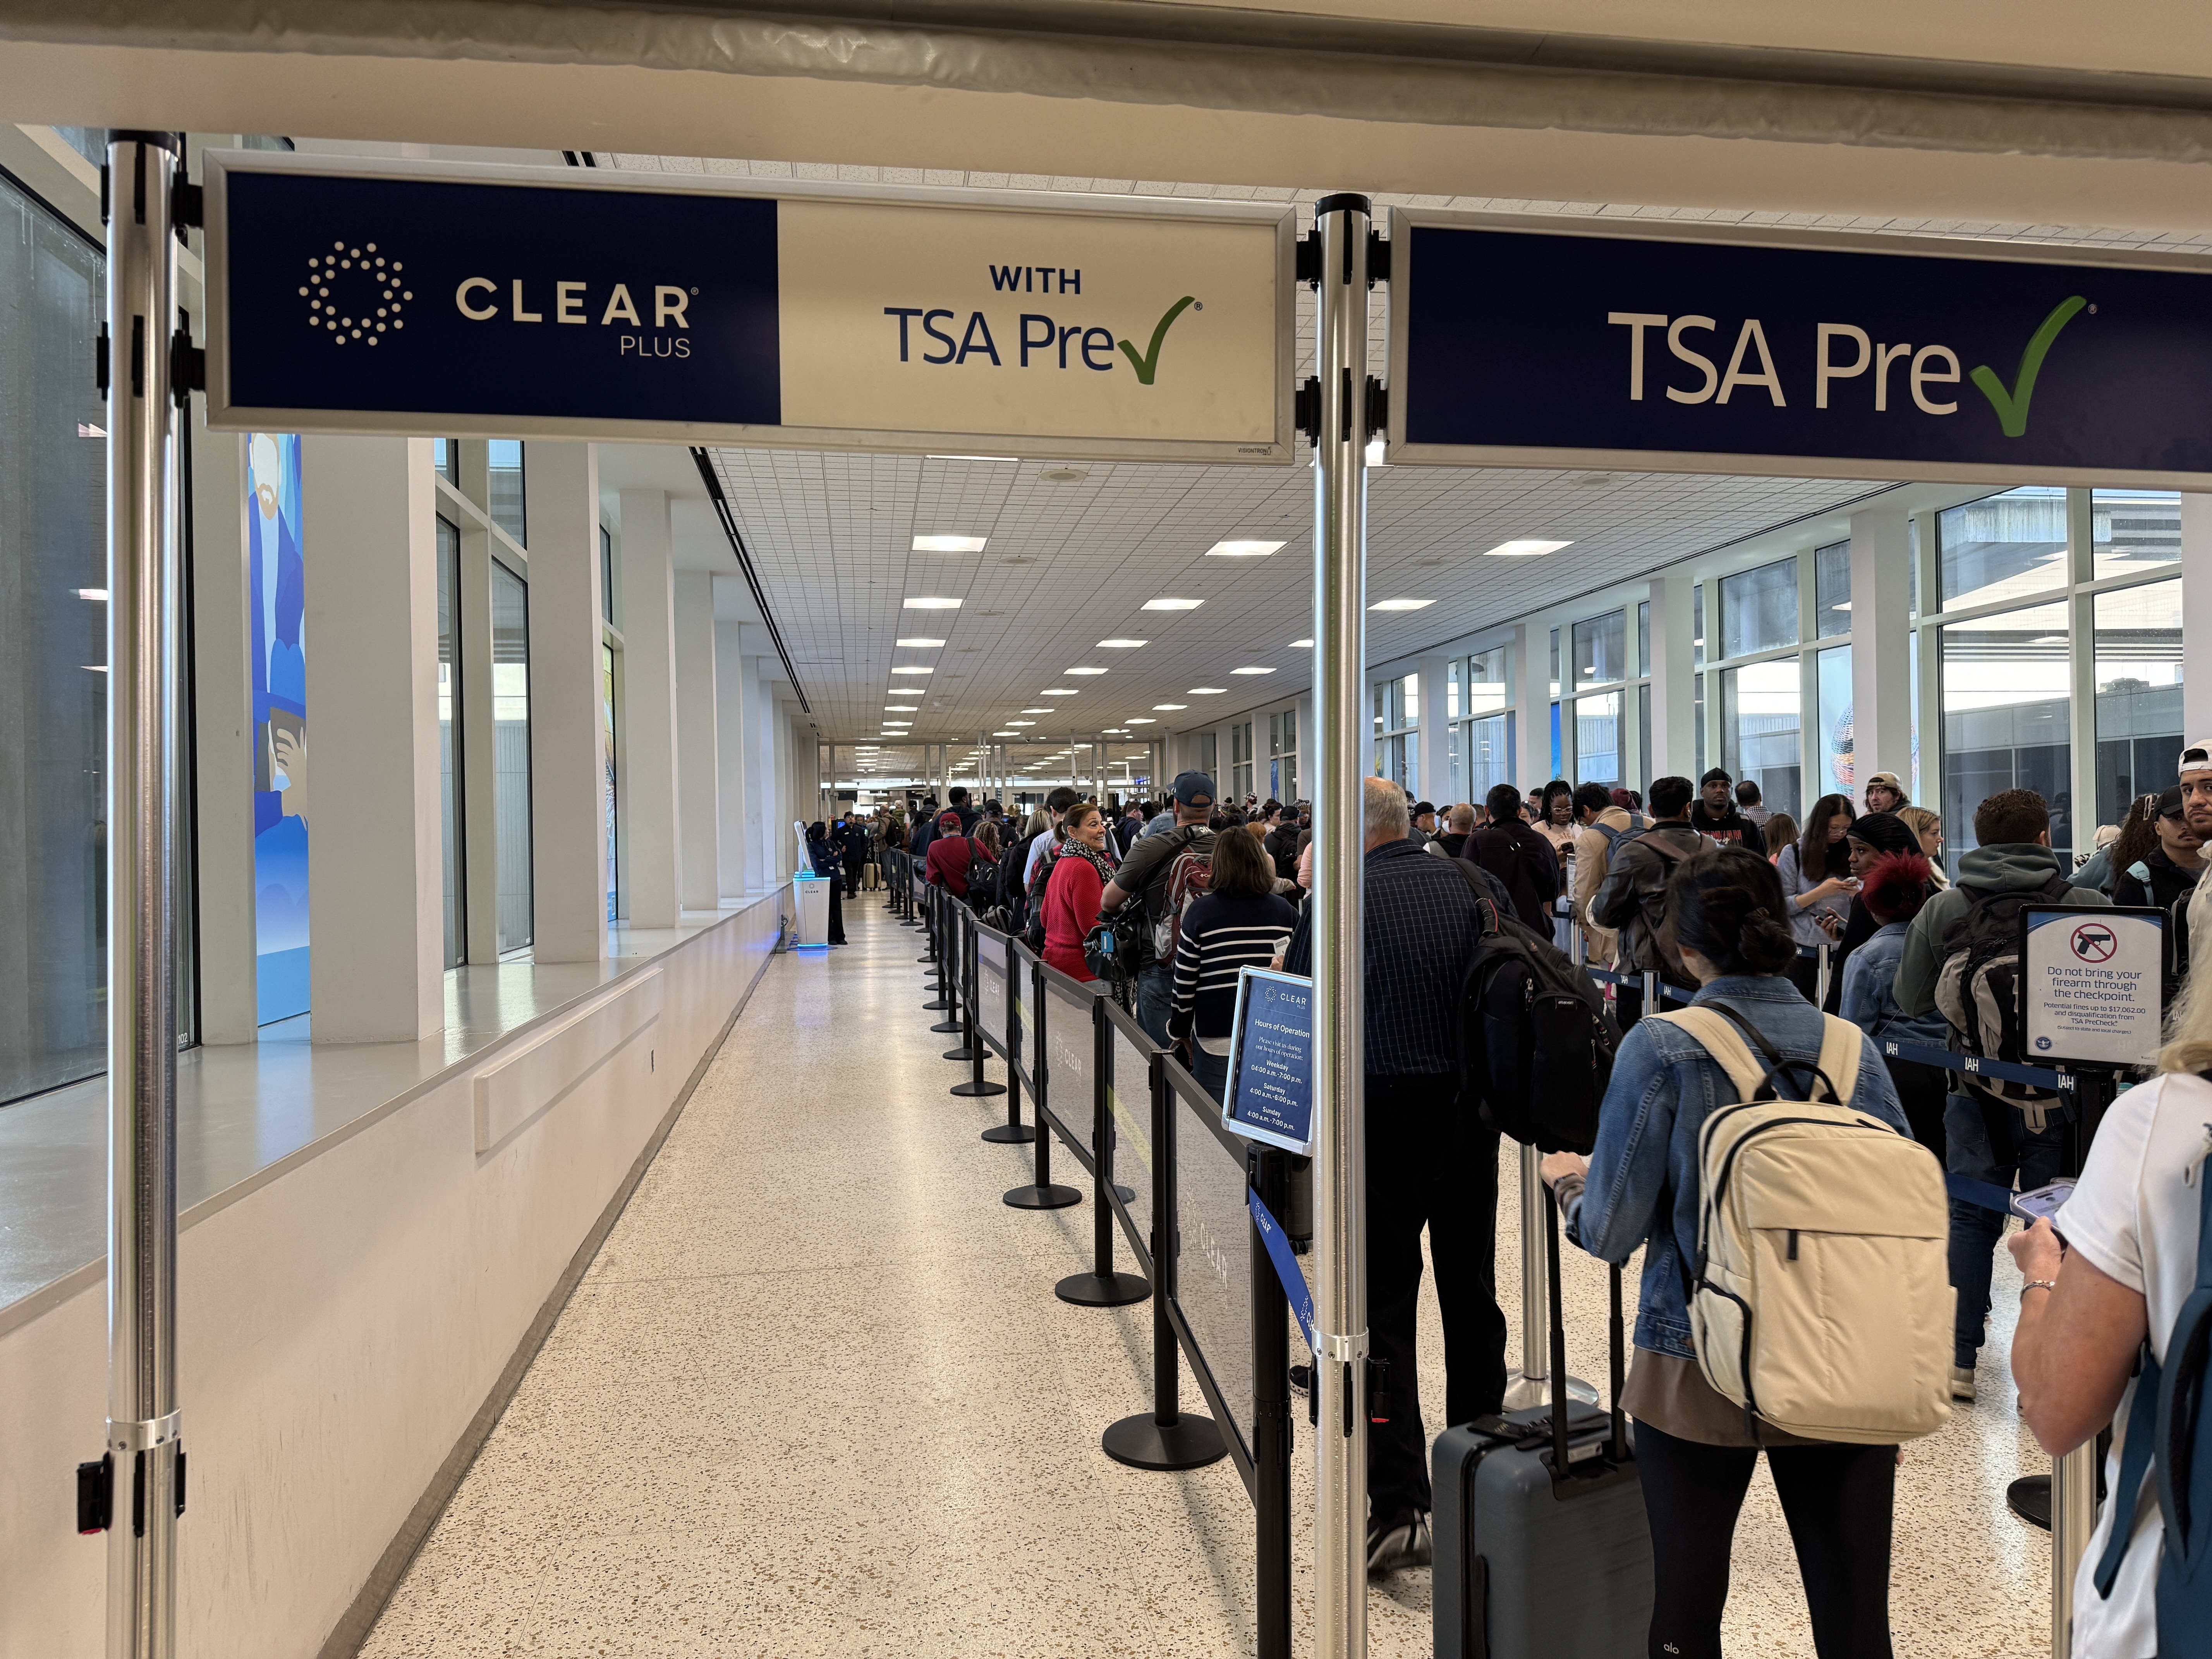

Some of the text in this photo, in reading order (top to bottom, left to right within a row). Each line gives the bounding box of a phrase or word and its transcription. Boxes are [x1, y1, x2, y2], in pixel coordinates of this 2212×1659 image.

[989, 264, 1081, 294] WITH
[884, 307, 1114, 371] TSA Pre
[620, 335, 691, 358] PLUS
[1608, 312, 1961, 415] TSA Pre
[2048, 967, 2142, 980] Do not bring your
[2052, 977, 2136, 991] firearm through
[2054, 989, 2135, 1001] the checkpoint.
[2068, 1011, 2117, 1019] disqualification
[1255, 1018, 1272, 1029] Hours
[1280, 1025, 1310, 1038] Operation
[1259, 1036, 1272, 1045] Please
[1287, 1044, 1302, 1054] during
[1886, 1041, 1898, 1055] IAH
[1065, 1048, 1081, 1077] CLEAR
[1281, 1051, 1303, 1061] operation:
[1251, 1065, 1266, 1073] 04:00
[1266, 1060, 1289, 1072] Weekday
[1965, 1057, 1978, 1072] IAH
[1264, 1083, 1285, 1095] Saturday
[2058, 1074, 2074, 1091] IAH
[1250, 1087, 1261, 1096] 4:00
[1247, 1111, 1259, 1119] 4:00
[1262, 1106, 1281, 1118] Sunday
[1200, 1222, 1227, 1289] CLEAR
[1664, 1642, 1679, 1654] alo
